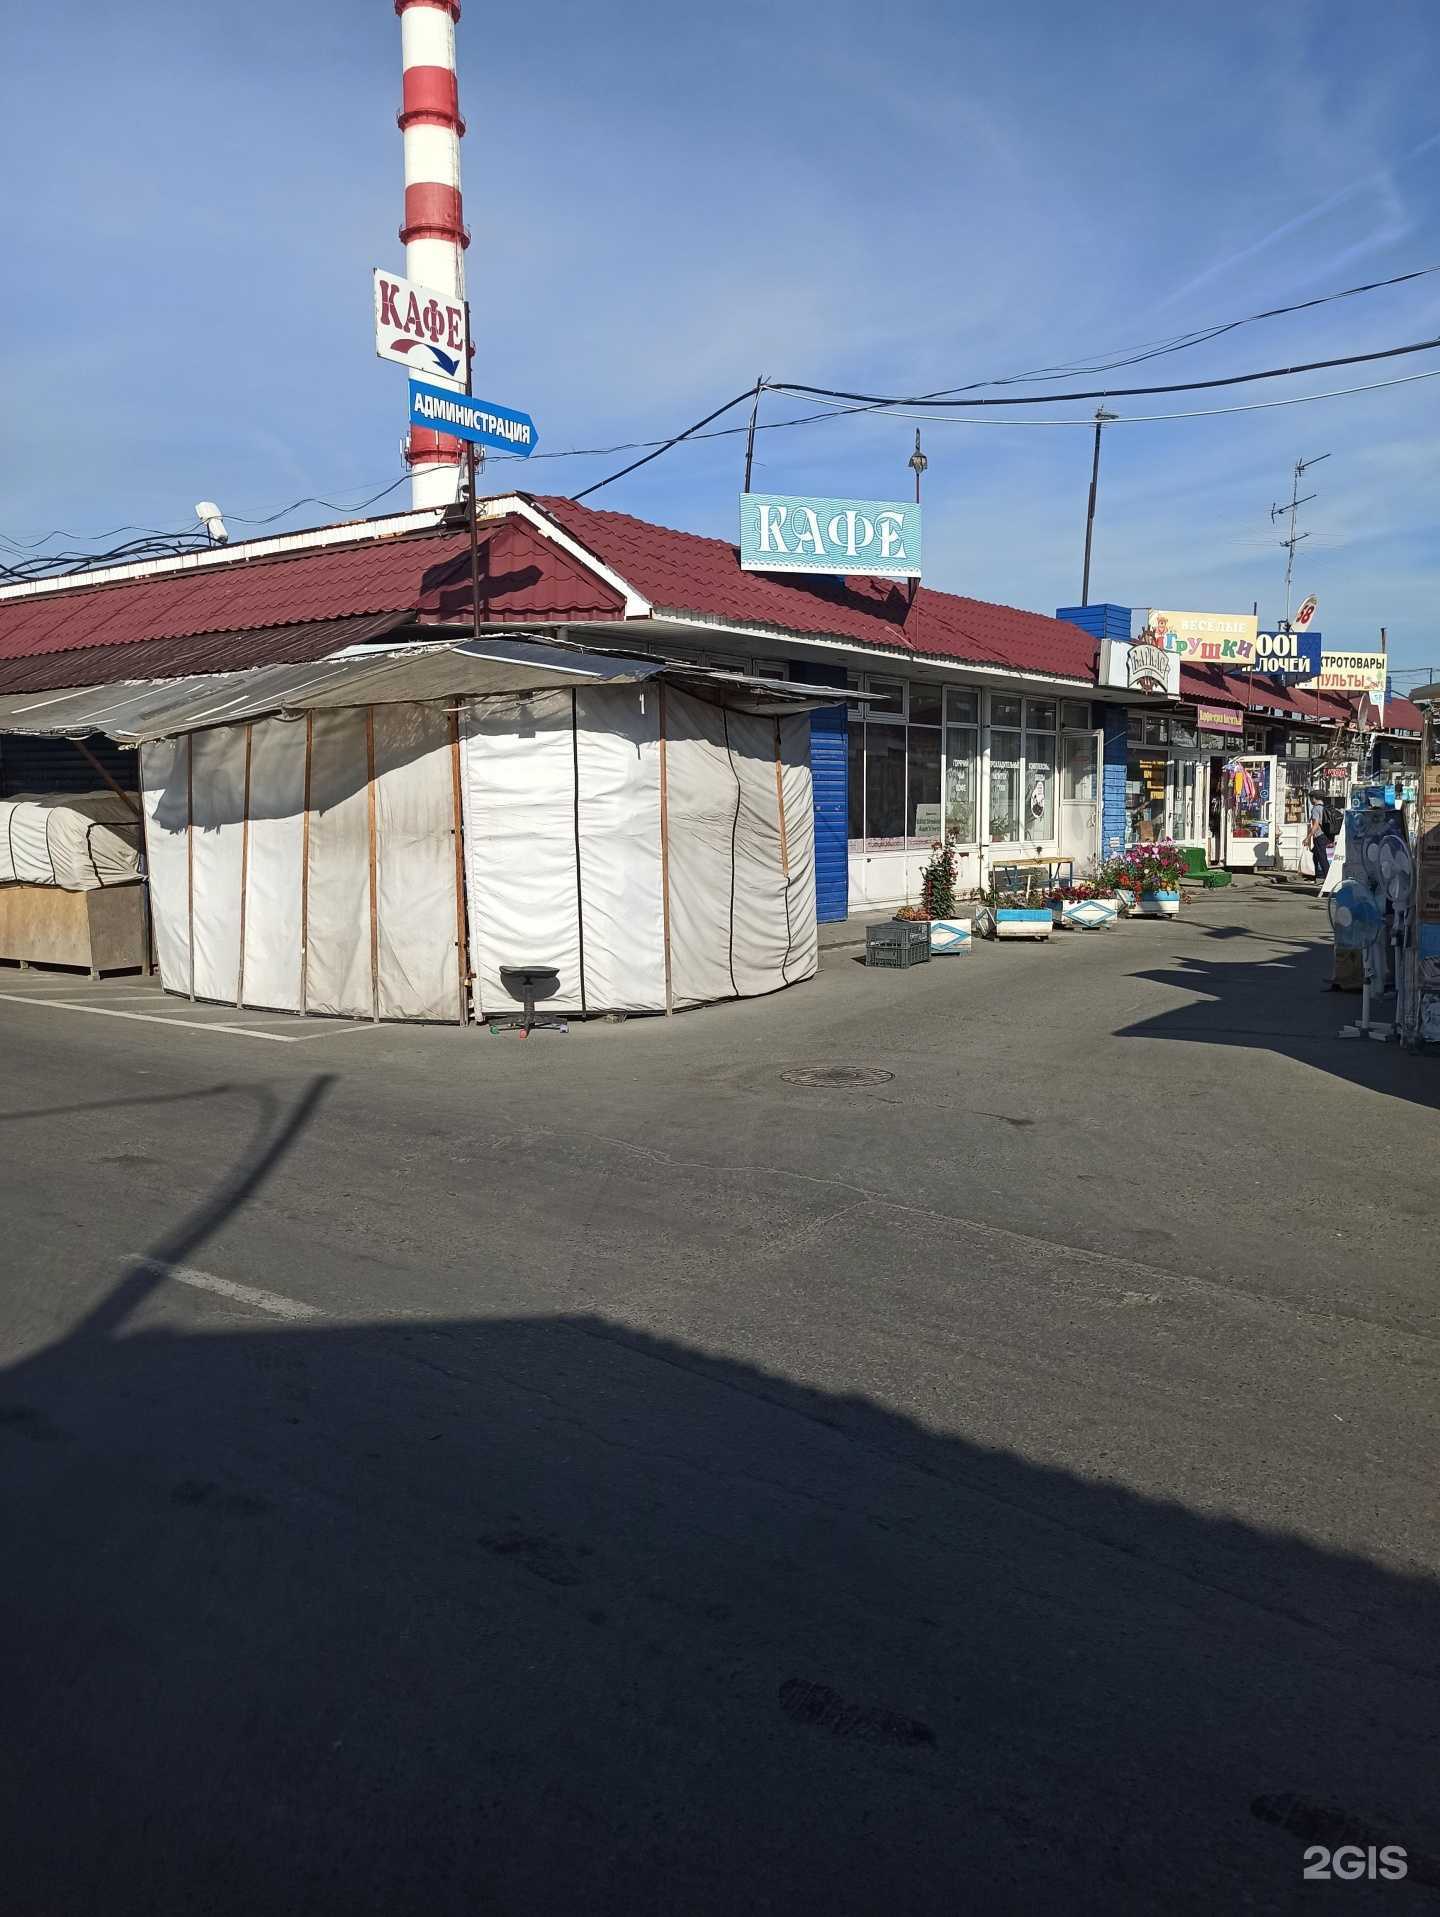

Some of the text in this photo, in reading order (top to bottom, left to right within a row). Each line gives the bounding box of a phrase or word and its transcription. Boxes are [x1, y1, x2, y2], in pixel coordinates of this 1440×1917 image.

[379, 279, 463, 351] КАФЕ
[414, 392, 530, 444] АДМИНИСТРАЦИЯ
[755, 504, 907, 559] КАФЕ
[1242, 656, 1311, 673] ЛОЧЕЙ
